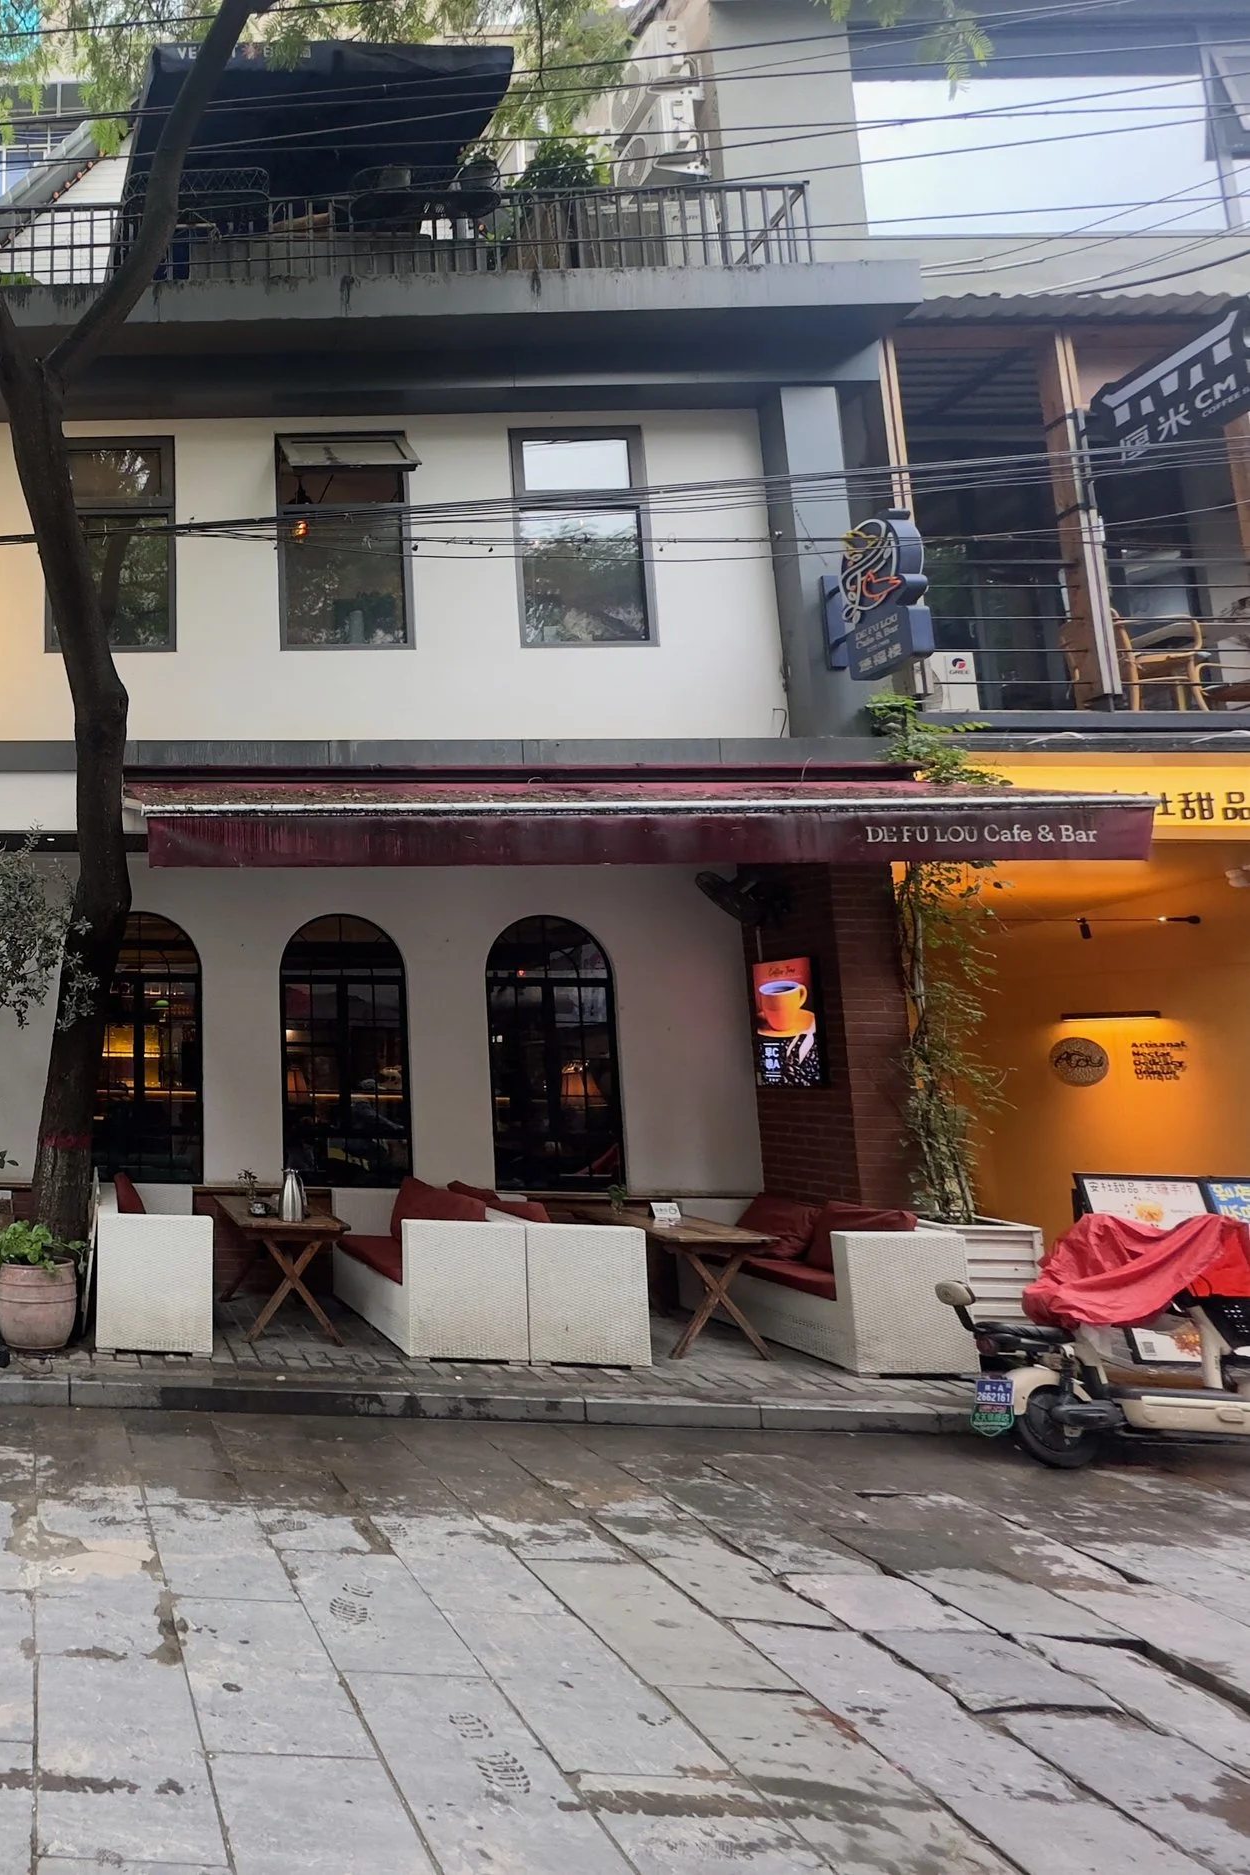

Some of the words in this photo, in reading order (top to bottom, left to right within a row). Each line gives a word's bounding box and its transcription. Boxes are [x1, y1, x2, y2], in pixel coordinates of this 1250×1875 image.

[1194, 374, 1237, 409] CM
[866, 826, 897, 843] DE
[901, 826, 928, 842] FU
[935, 826, 977, 842] LOU
[984, 825, 1032, 842] Cafe
[1037, 825, 1055, 842] &
[1061, 825, 1097, 843] Bar
